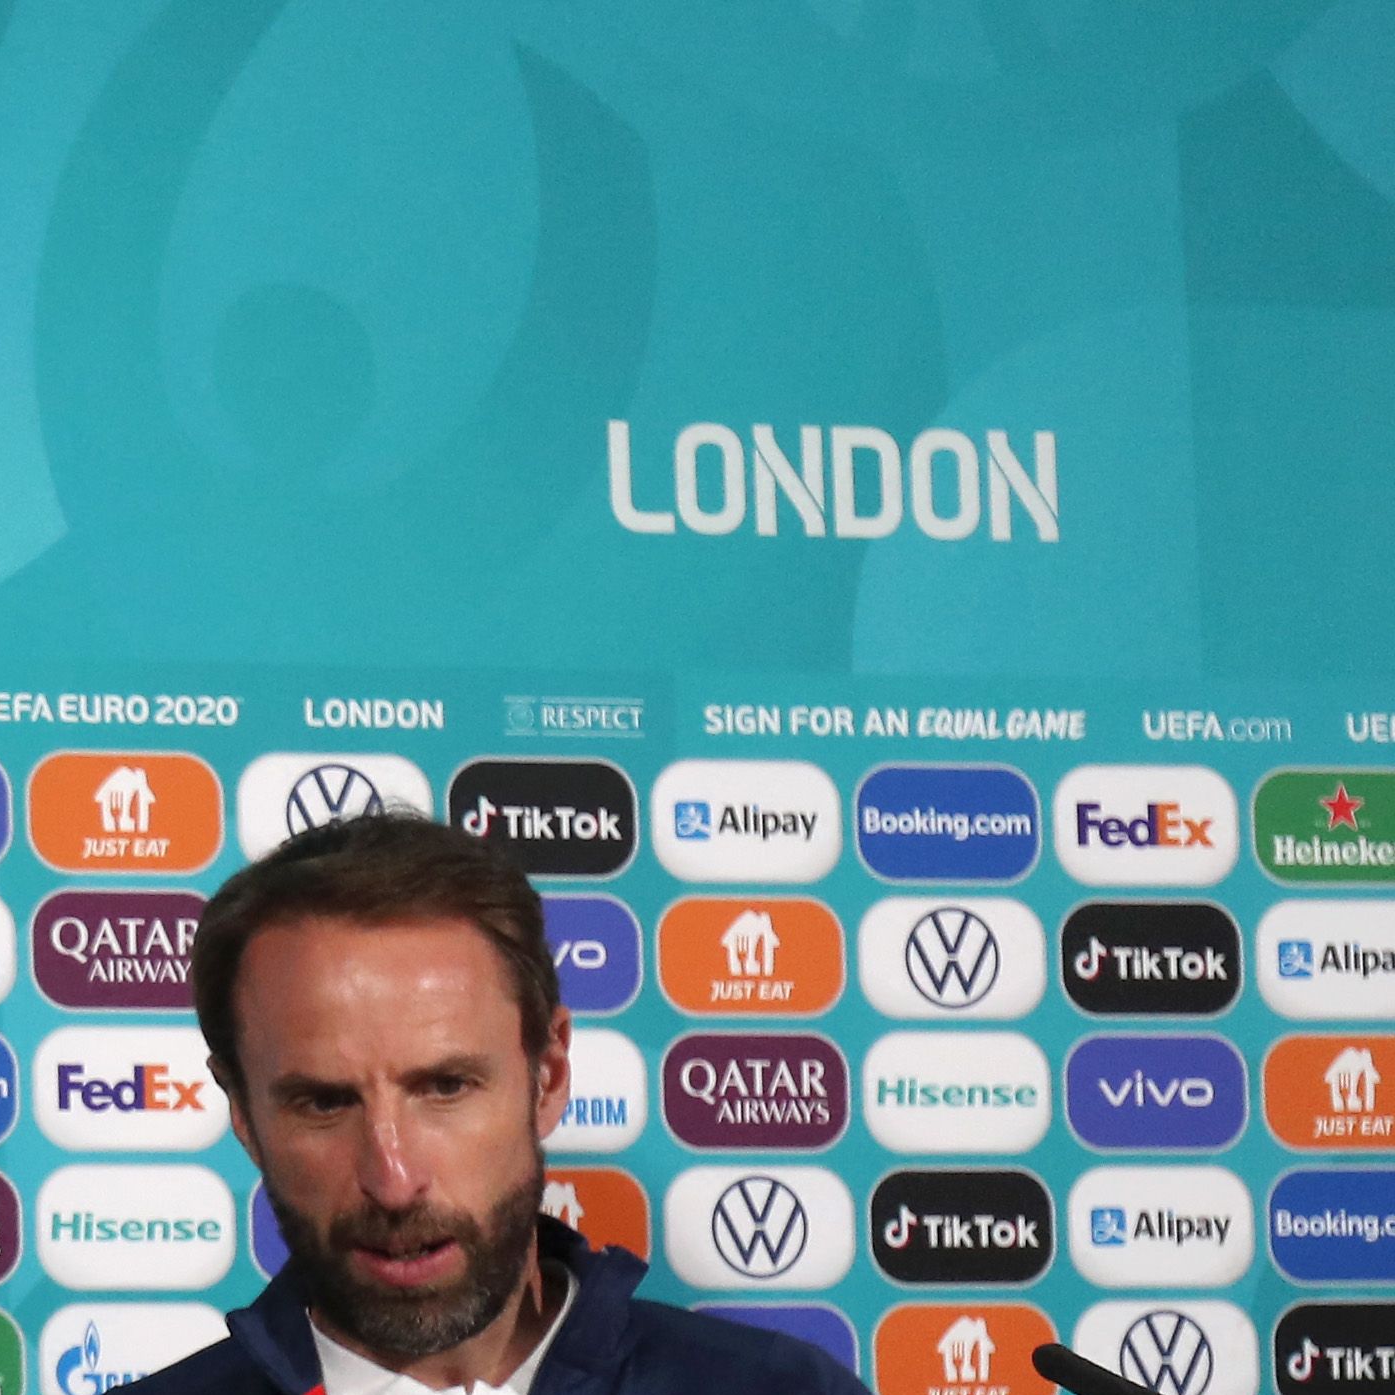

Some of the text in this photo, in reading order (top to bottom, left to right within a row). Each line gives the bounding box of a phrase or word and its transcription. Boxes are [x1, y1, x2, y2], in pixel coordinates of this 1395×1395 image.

[609, 421, 1058, 541] LONDON
[58, 694, 149, 723] EURO
[154, 695, 238, 725] 2020
[305, 698, 443, 728] LONDON
[543, 705, 642, 730] RESPECT
[705, 705, 1084, 740] SIGN FOR AN EQUAL GAME
[1143, 711, 1291, 740] UEFA.com
[502, 806, 621, 840] TikTok
[719, 805, 817, 840] Alipay
[863, 807, 1031, 841] Booking.com
[1076, 803, 1211, 848] FedEx
[83, 838, 170, 858] JUST EAT
[1112, 947, 1226, 979] TikTok
[711, 981, 794, 1001] JUST EAT
[58, 1064, 202, 1112] FedEx
[680, 1059, 826, 1100] QATAR
[877, 1078, 1037, 1107] Hisense
[1099, 1070, 1213, 1106] vivo
[718, 1099, 829, 1123] AIRWAYS
[1314, 1116, 1393, 1138] JUST EAT
[51, 1212, 221, 1241] Hisense
[923, 1215, 1038, 1247] TikTok
[1134, 1210, 1230, 1245] Alipay
